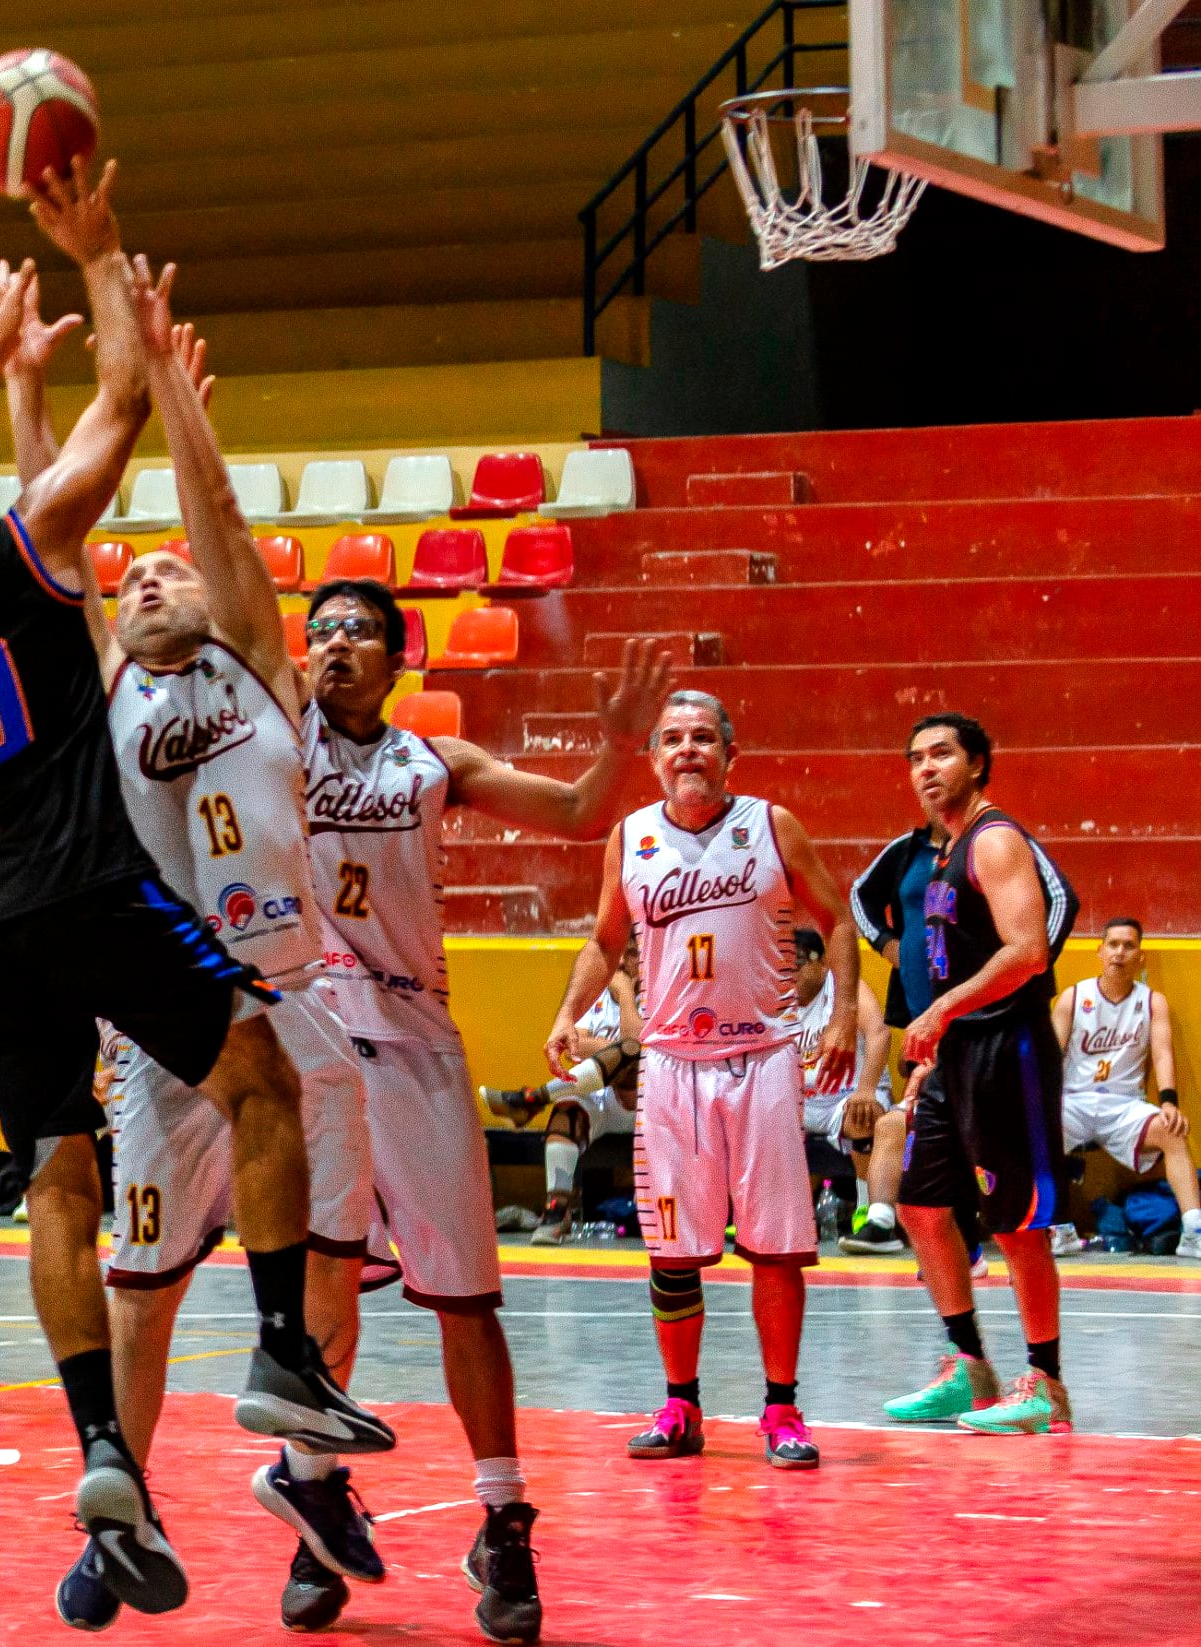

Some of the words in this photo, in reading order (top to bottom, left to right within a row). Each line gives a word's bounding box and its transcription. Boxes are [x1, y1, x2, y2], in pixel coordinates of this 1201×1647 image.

[197, 792, 244, 858] 13
[334, 858, 370, 920] 22
[639, 857, 758, 928] Vallesol
[687, 932, 716, 982] 17
[126, 1183, 162, 1246] 13
[657, 1196, 677, 1241] 17
